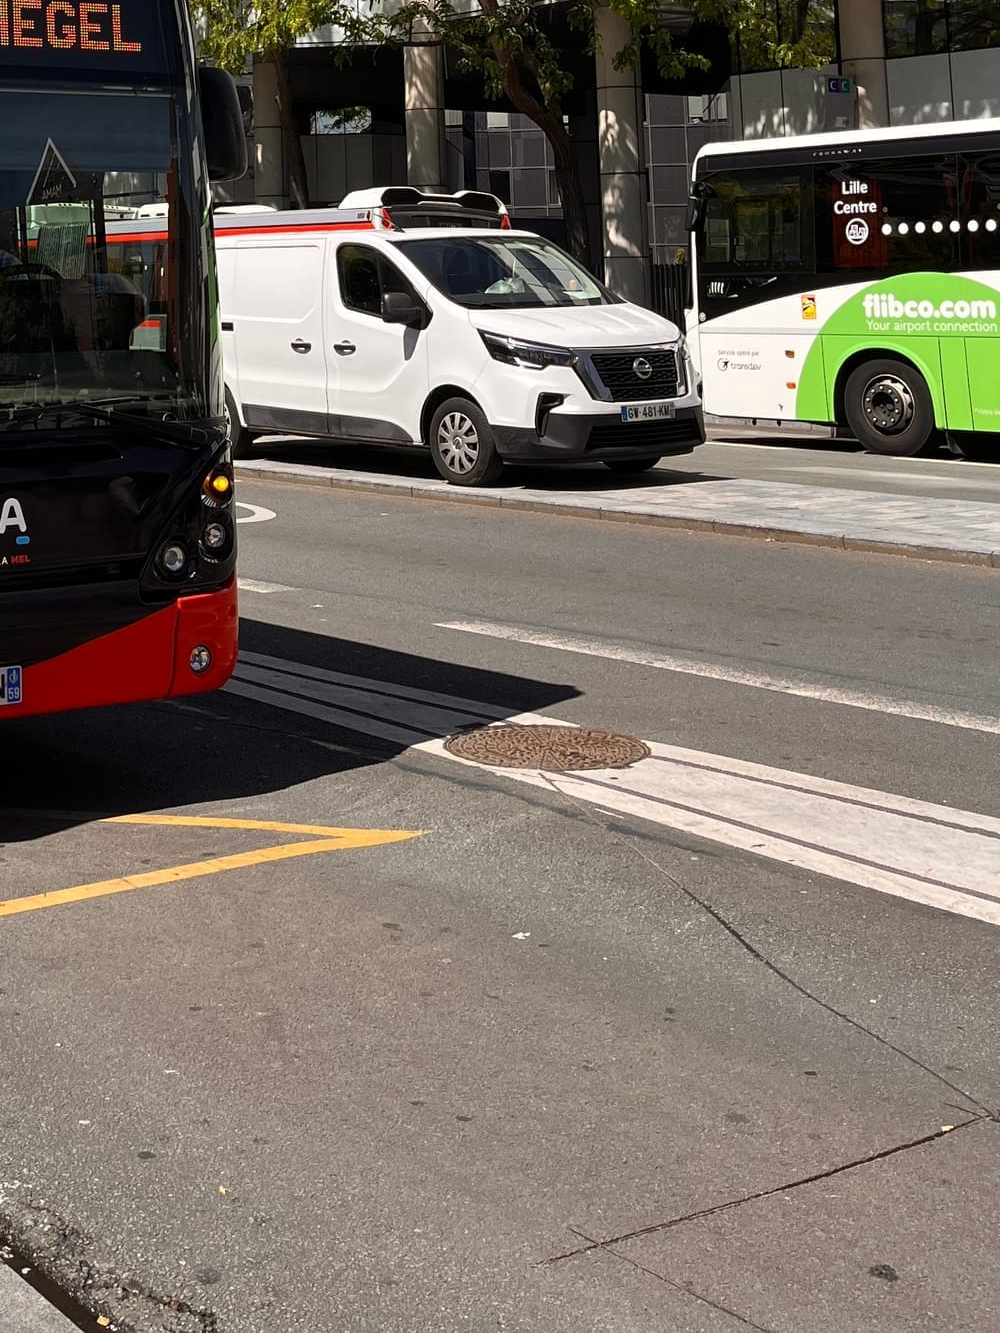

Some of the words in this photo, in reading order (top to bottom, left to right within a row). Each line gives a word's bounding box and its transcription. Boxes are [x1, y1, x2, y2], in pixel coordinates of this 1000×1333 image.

[841, 180, 868, 195] Lille
[833, 200, 877, 215] Centre
[862, 293, 997, 319] flibco.com
[866, 320, 891, 331] Your
[893, 320, 931, 334] airport
[933, 321, 998, 332] connection
[7, 686, 20, 700] 59
